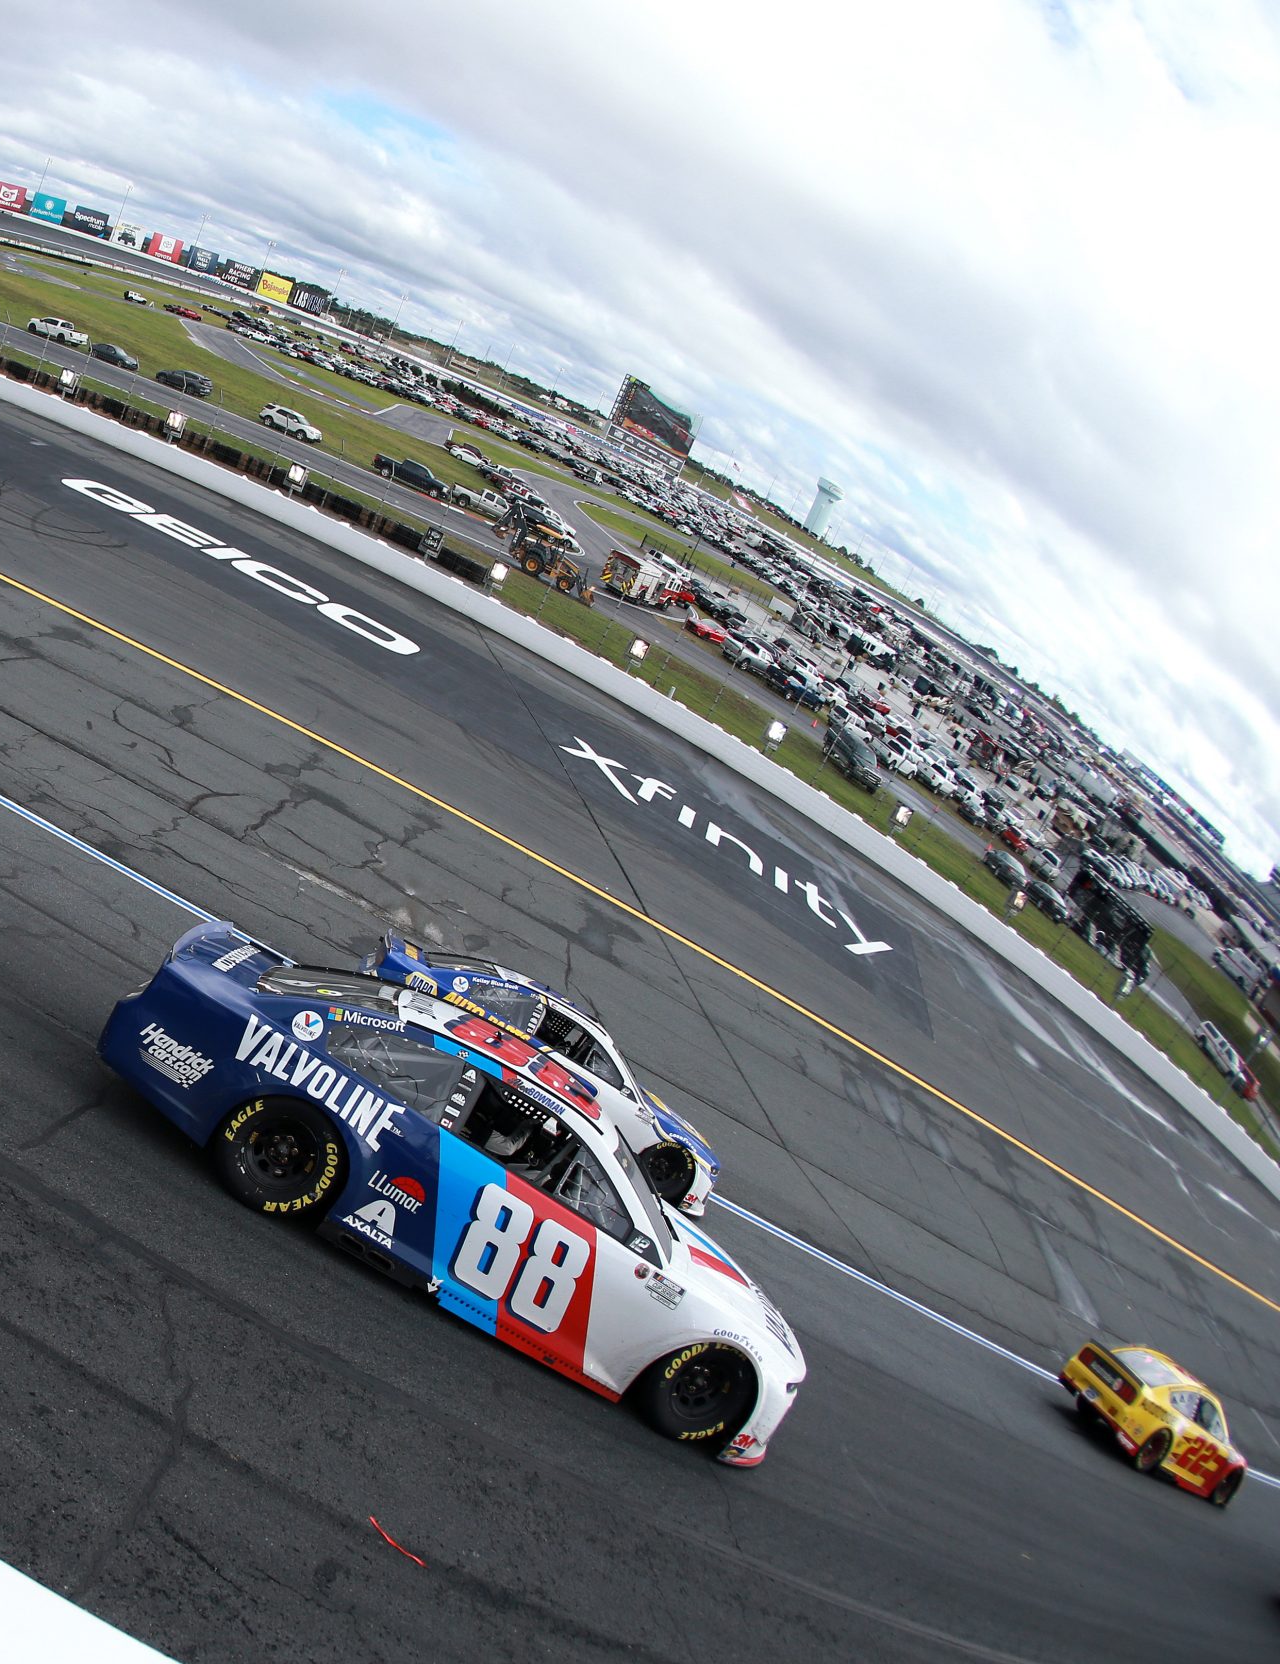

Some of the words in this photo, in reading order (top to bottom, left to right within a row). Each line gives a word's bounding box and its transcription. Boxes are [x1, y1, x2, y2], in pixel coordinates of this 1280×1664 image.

[74, 211, 106, 227] Spectrum
[154, 251, 172, 261] TOYOTA
[234, 262, 256, 274] WHERE
[228, 268, 251, 281] RACING
[293, 290, 308, 308] LAS
[306, 293, 325, 314] VEGAS
[61, 478, 421, 656] GEICO
[491, 978, 504, 988] Blue
[294, 1020, 317, 1039] VALVOLINE
[344, 1010, 407, 1033] Microsoft
[140, 1022, 215, 1077] Hendrick
[148, 1044, 204, 1081] cars.com
[235, 1013, 406, 1153] VALVOLINE
[528, 1087, 567, 1116] BOWMAN
[224, 1099, 264, 1142] EAGLE
[263, 1142, 339, 1213] GOODYEAR
[684, 1193, 699, 1204] 3M
[342, 1214, 395, 1250] AXALTA
[454, 1182, 591, 1333] 88
[713, 1328, 764, 1363] GOODYEAR
[677, 1420, 725, 1440] EAGLE
[732, 1432, 758, 1450] 3M
[1176, 1436, 1222, 1478] 22
